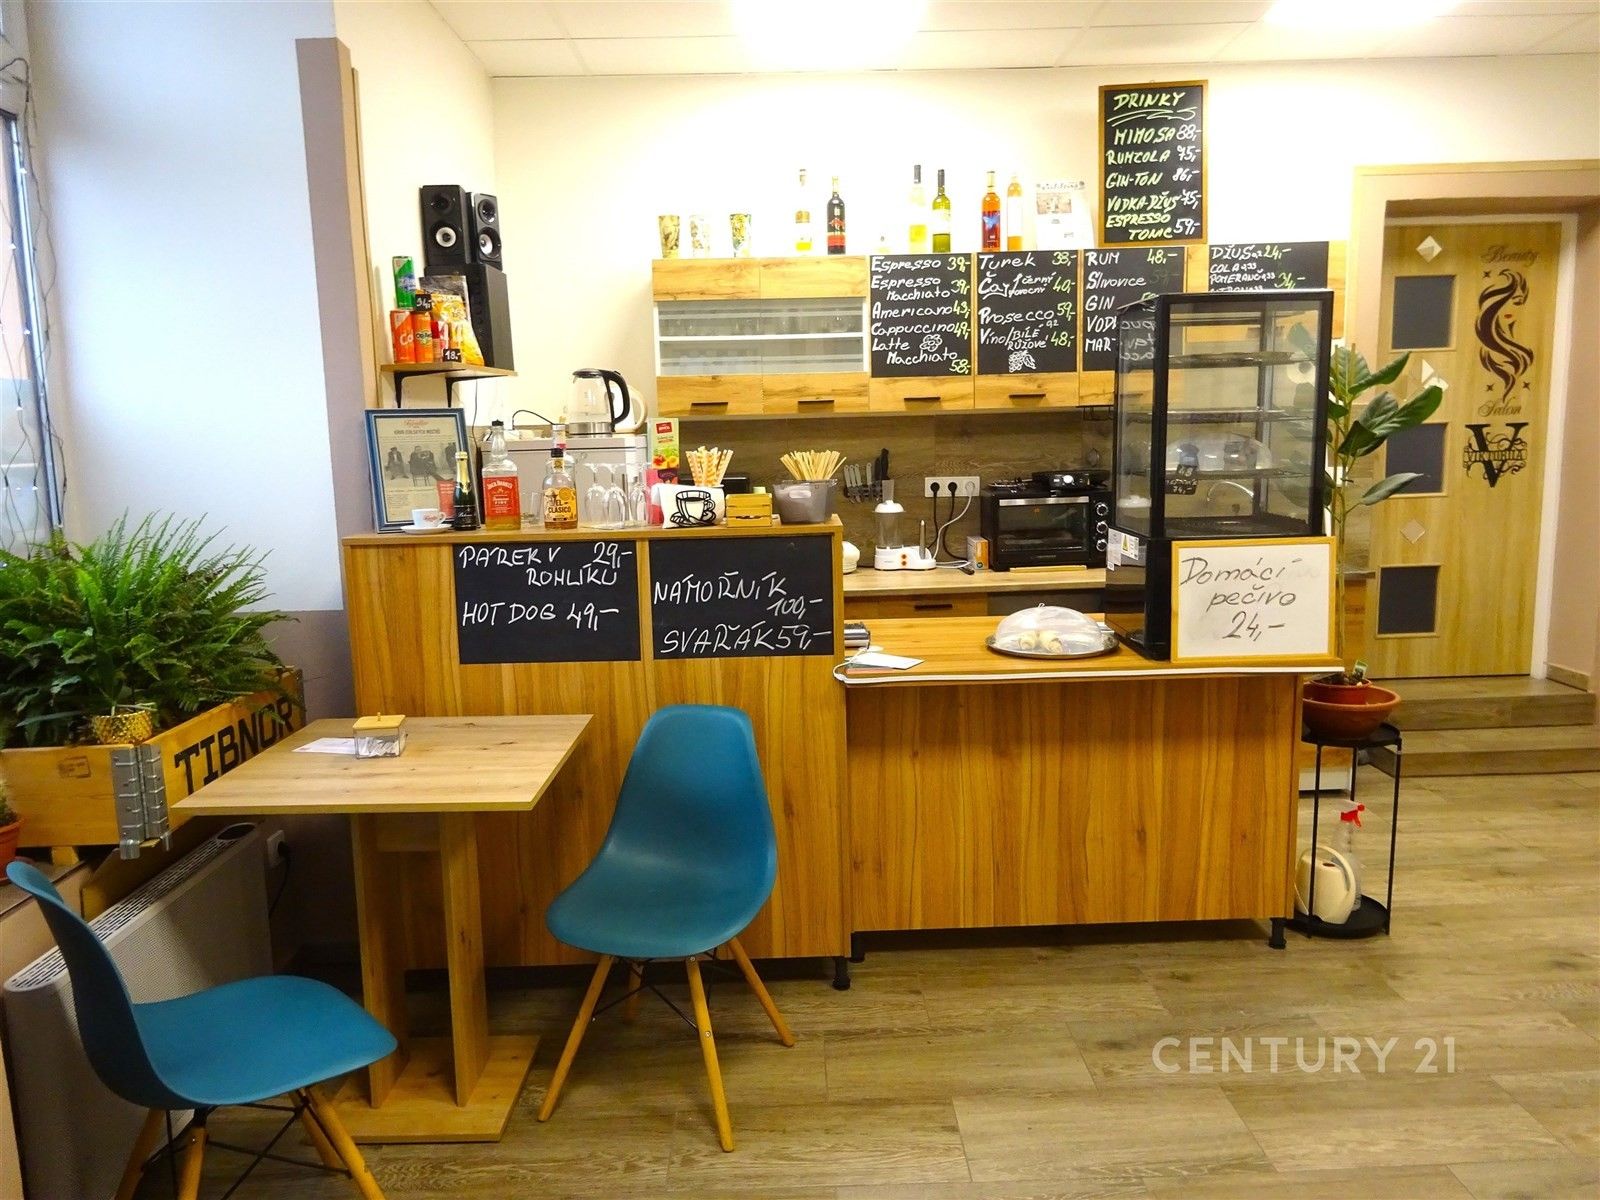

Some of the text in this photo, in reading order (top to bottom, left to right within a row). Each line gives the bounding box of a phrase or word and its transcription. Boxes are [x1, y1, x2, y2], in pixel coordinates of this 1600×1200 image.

[1113, 92, 1186, 111] DRINKY
[1114, 124, 1201, 145] MIMOSA 88,-
[1177, 145, 1201, 162] 75,-
[1106, 172, 1163, 189] GIN-TON
[1106, 213, 1171, 228] ESPRESSO
[1128, 227, 1173, 241] TONIC
[979, 252, 1036, 269] Turek
[1085, 249, 1178, 267] RUM 48,-
[1263, 245, 1292, 260] 24,-
[871, 256, 942, 274] Espresso
[1210, 263, 1240, 274] COLA
[871, 275, 942, 290] Espresso
[1086, 271, 1147, 290] Slivovice
[886, 286, 950, 301] Macchiato
[872, 301, 953, 319] Americano
[1085, 295, 1115, 312] GIN
[978, 307, 1055, 325] Prosecco
[871, 322, 955, 336] Cappuccino
[872, 337, 910, 351] Latte
[886, 347, 957, 365] Macchiato
[592, 541, 632, 569] 29,-
[526, 562, 617, 587] ROHLÍKU
[1179, 557, 1303, 587] Domácí
[766, 595, 824, 620] 100,-
[1206, 584, 1297, 613] pečivo
[462, 601, 620, 632] HOT DOG 49,-
[1222, 610, 1286, 642] 24,-
[660, 620, 832, 654] SVAŘÁK 59,-
[174, 696, 294, 796] TIBNOR
